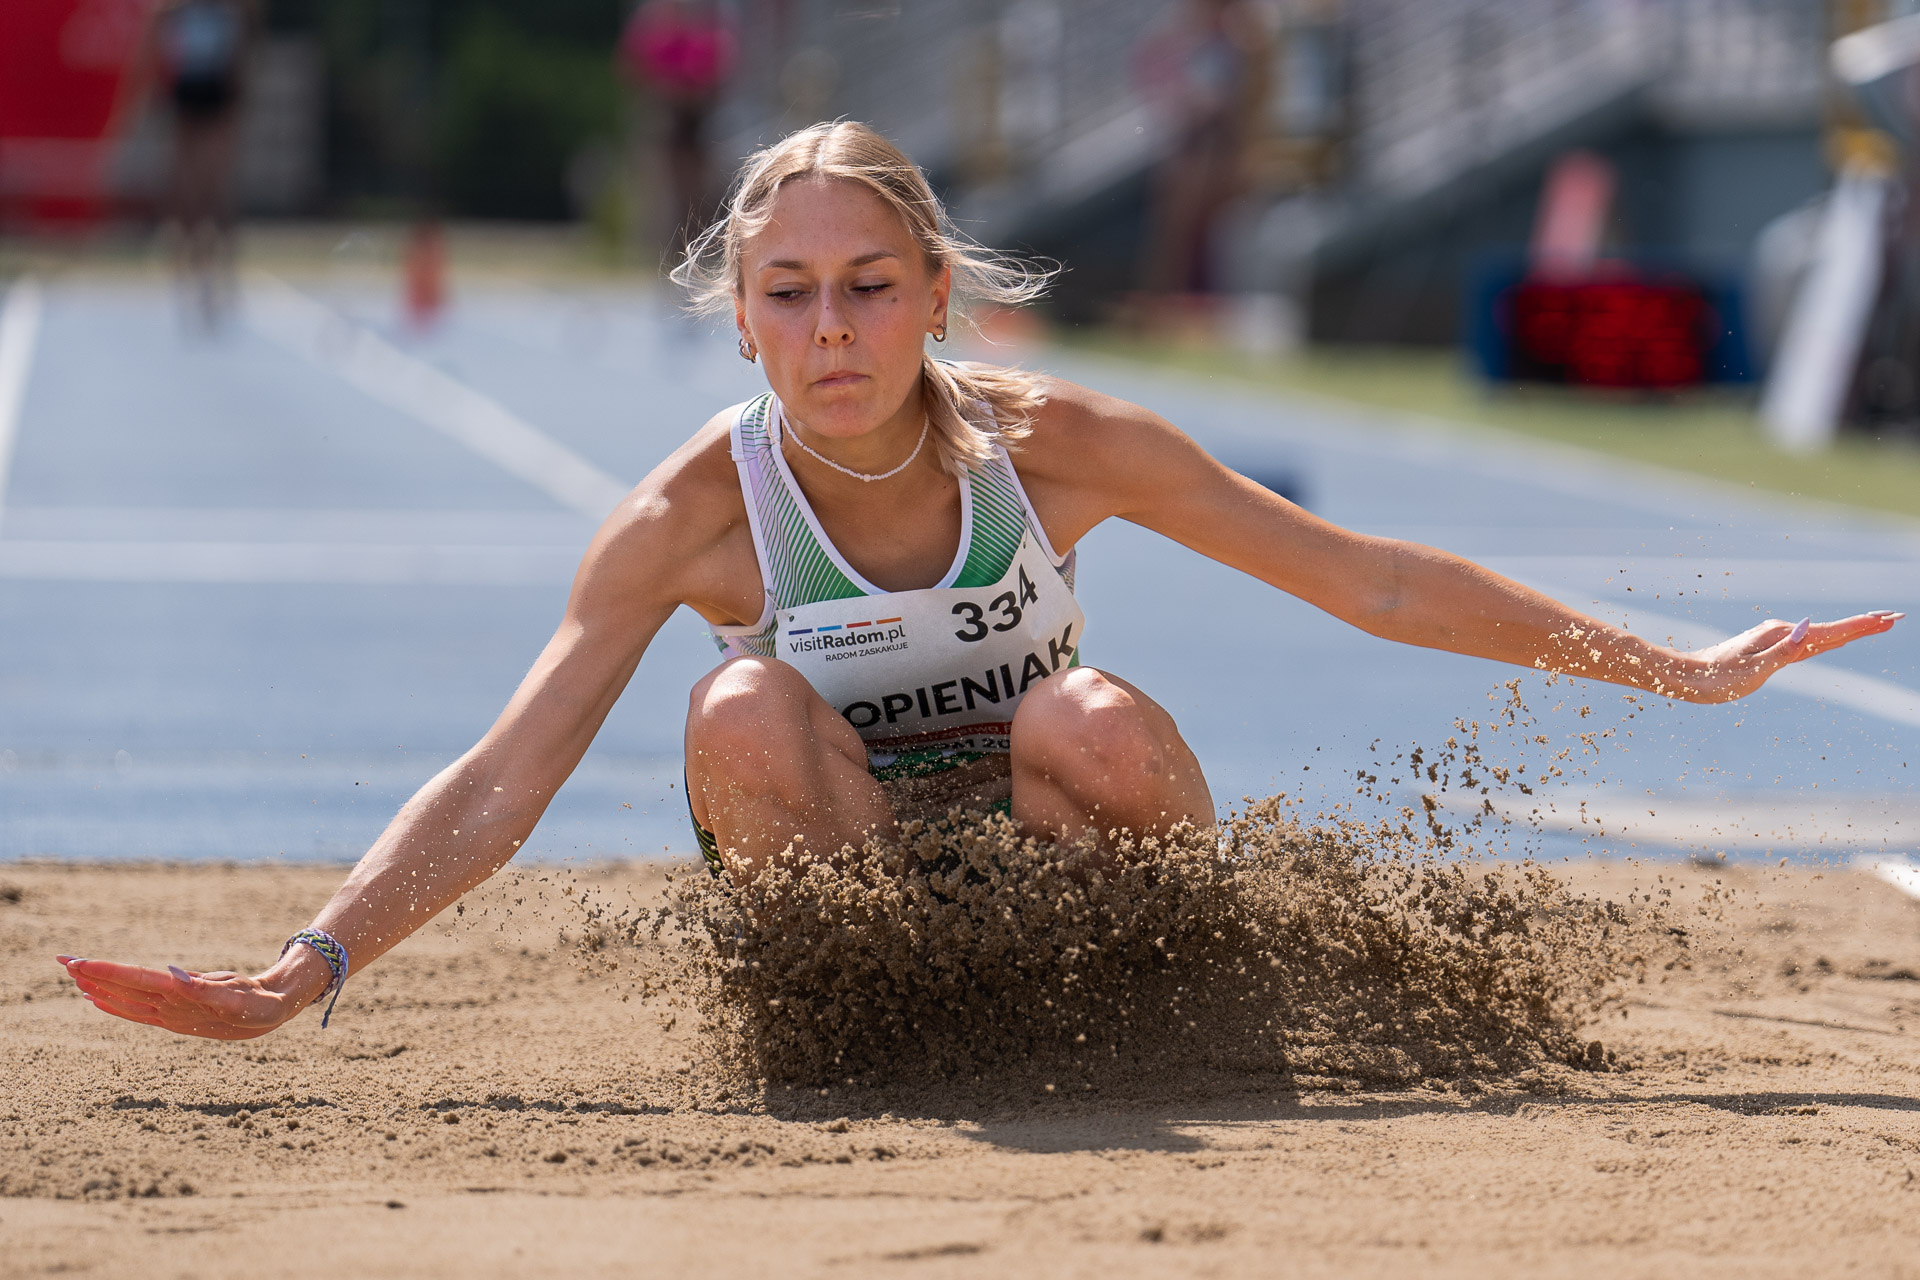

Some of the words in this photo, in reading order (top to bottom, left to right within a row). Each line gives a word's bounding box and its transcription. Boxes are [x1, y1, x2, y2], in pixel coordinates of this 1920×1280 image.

[951, 562, 1039, 643] 334
[789, 624, 906, 653] visitRadom.pl
[825, 650, 858, 662] RADOM
[859, 641, 909, 657] ZASKAKUJE
[834, 622, 1075, 730] OPIENIAK
